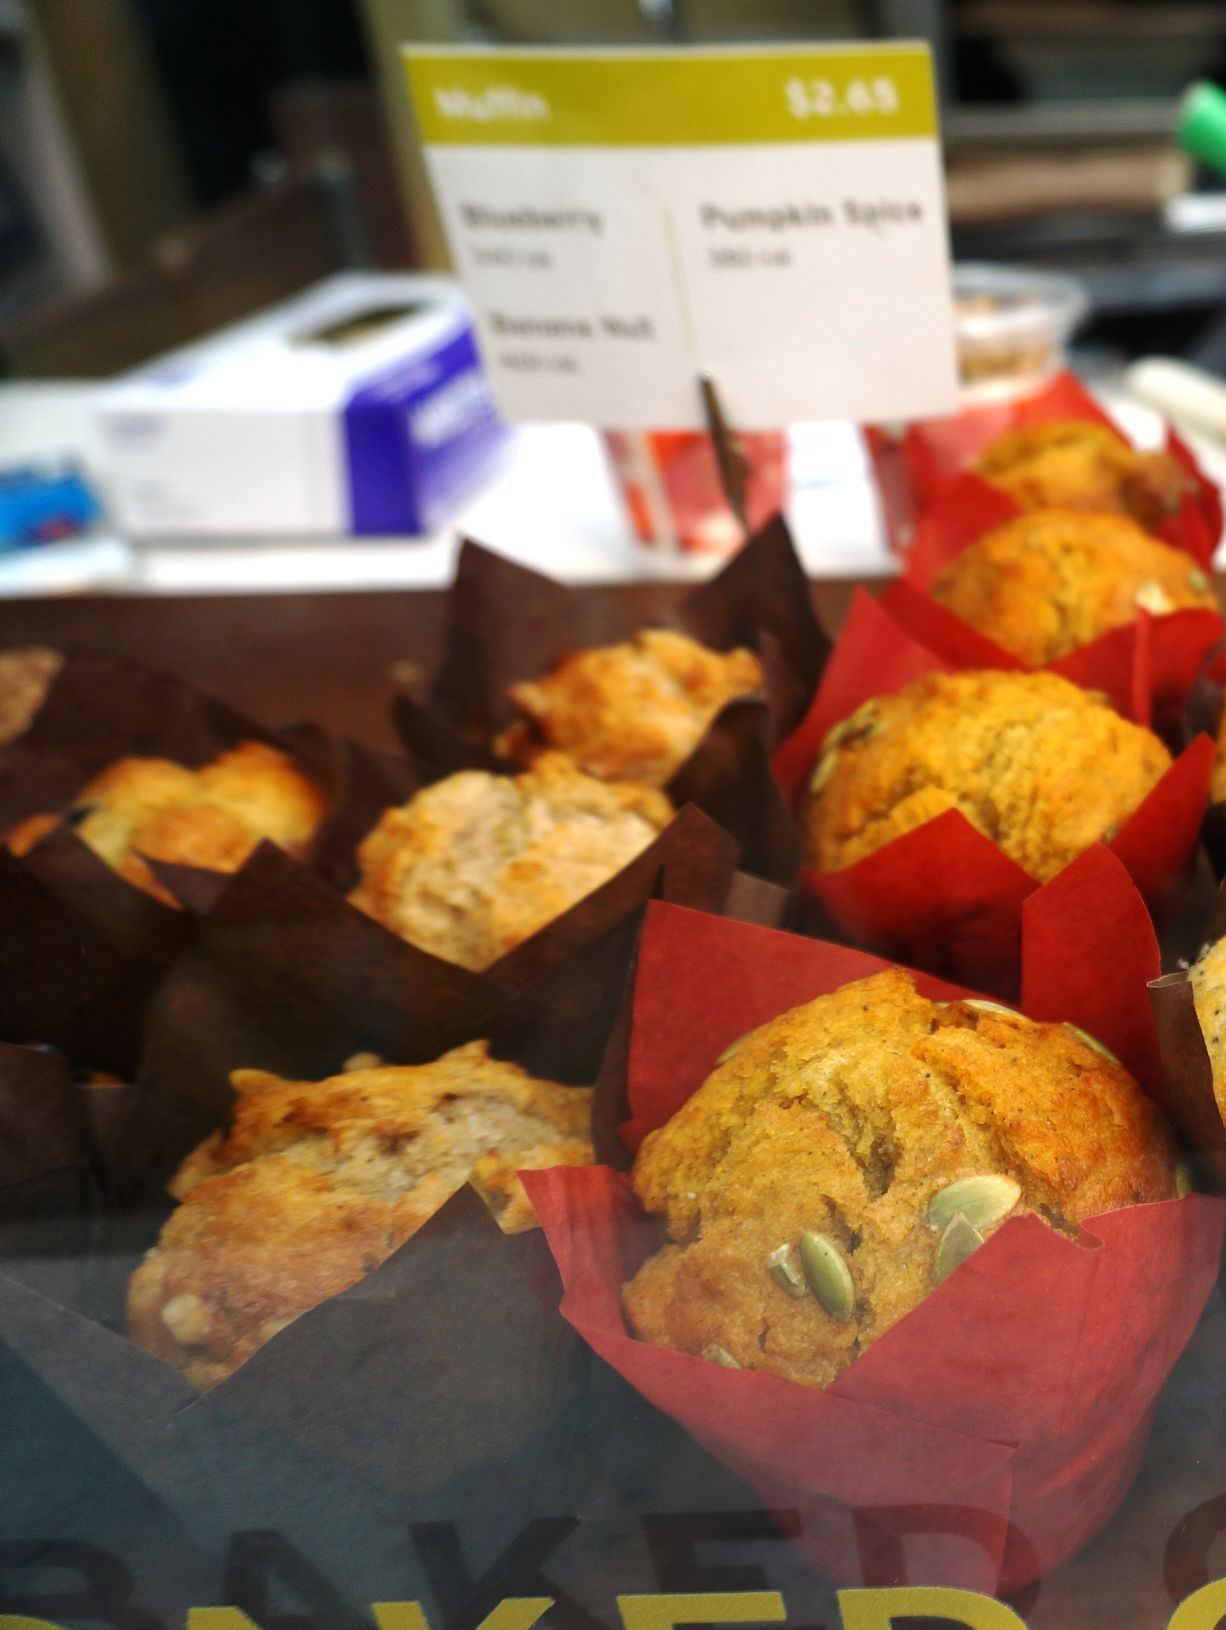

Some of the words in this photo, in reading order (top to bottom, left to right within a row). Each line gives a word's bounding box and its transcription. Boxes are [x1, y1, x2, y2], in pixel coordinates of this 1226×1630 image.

[431, 85, 551, 123] Muffin
[785, 75, 898, 121] $2.65
[461, 202, 602, 238] Blueberry
[700, 201, 831, 233] Pumpkin
[844, 197, 923, 235] Spice
[490, 314, 592, 341] Banana
[603, 314, 654, 342] Nut
